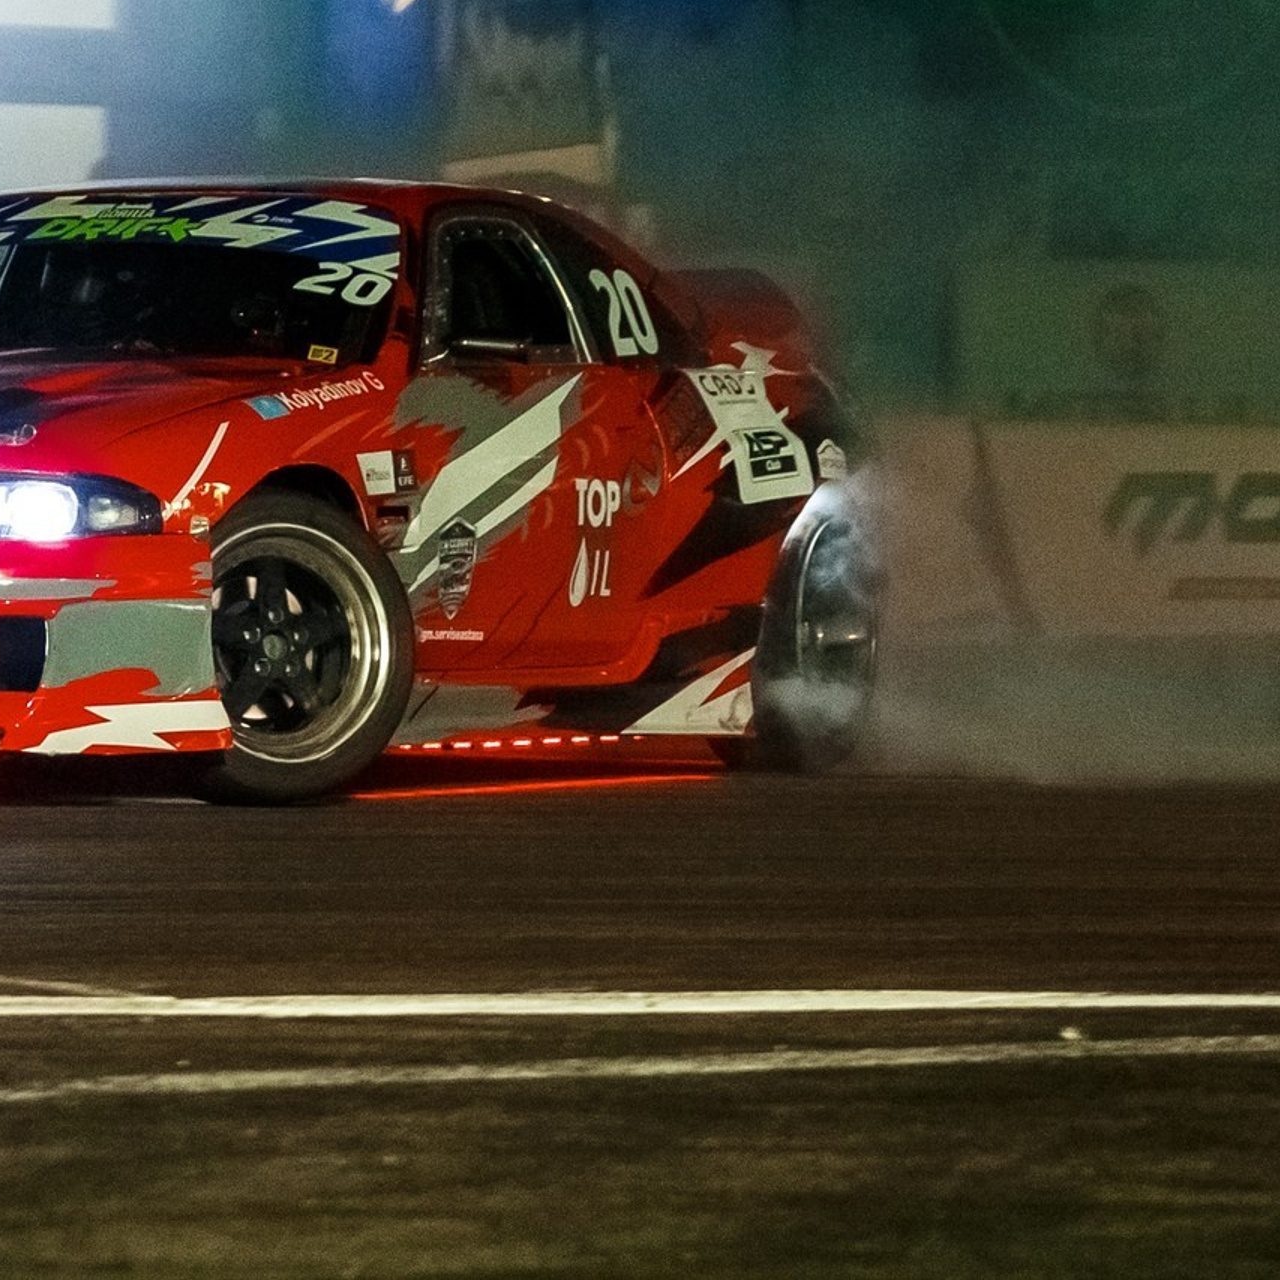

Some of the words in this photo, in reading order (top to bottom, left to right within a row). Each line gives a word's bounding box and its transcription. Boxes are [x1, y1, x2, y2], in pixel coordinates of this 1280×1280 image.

[26, 218, 207, 242] DRIFT
[292, 261, 393, 306] 20
[589, 269, 658, 357] 20
[274, 377, 369, 410] Kolyadinov
[362, 371, 385, 390] G
[575, 478, 620, 528] TOP
